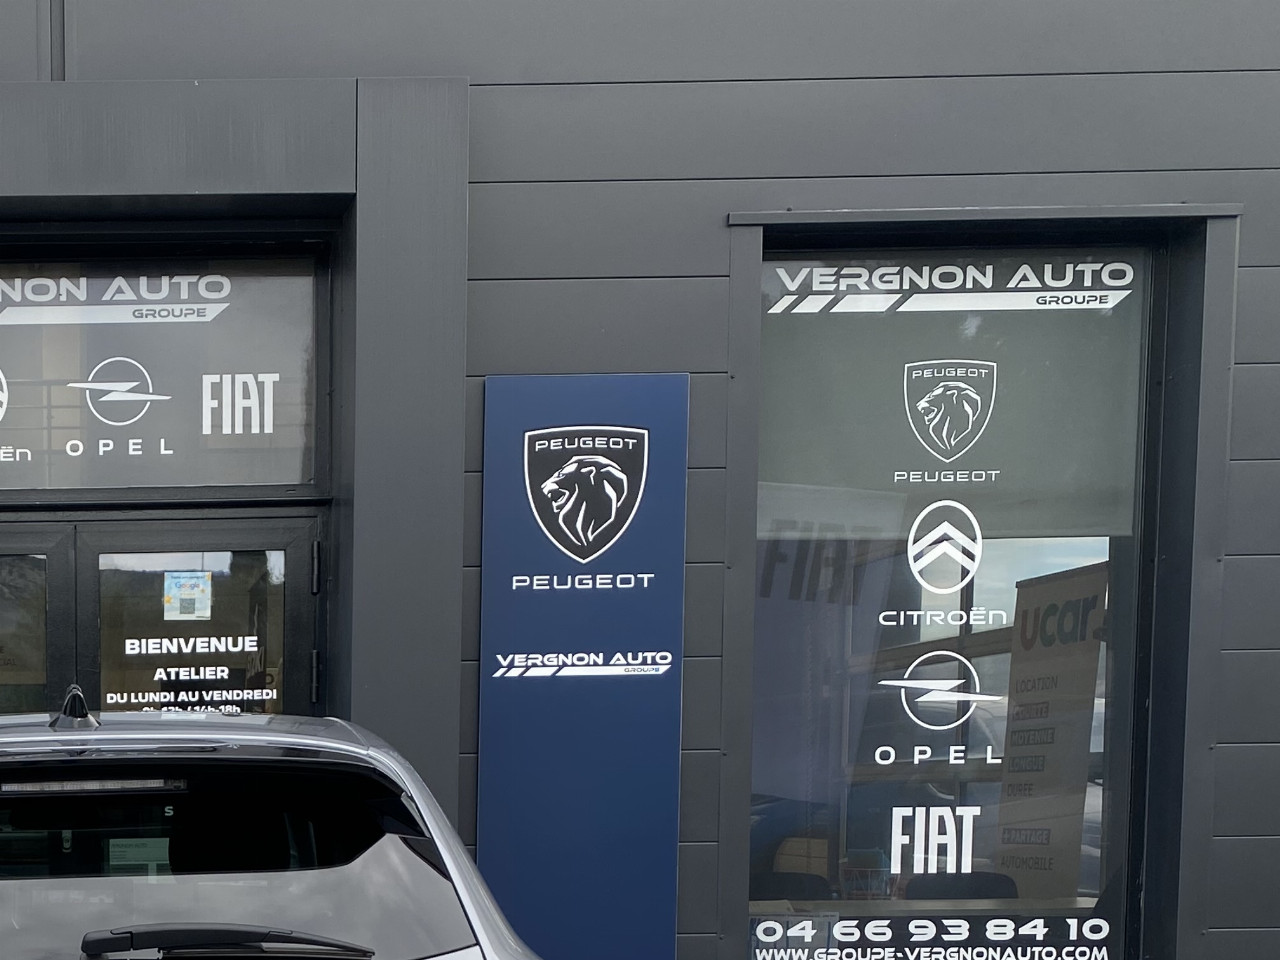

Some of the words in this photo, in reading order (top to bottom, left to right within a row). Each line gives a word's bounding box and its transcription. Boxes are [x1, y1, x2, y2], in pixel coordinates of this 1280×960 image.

[775, 264, 993, 292] VERGNON
[1005, 262, 1135, 288] AUTO
[101, 275, 232, 301] AUTO
[1035, 294, 1109, 305] GROUPE
[132, 308, 207, 319] GROUPE
[911, 367, 989, 379] PEUGEOT
[202, 373, 279, 435] FIAT
[65, 438, 174, 457] OPEL
[535, 437, 637, 452] PEUGEOT
[894, 470, 1001, 483] PEUGEOT
[512, 573, 655, 590] PEUGEOT
[878, 607, 1007, 626] CITROËN
[1020, 595, 1098, 651] ucar
[125, 636, 258, 655] BIENVENUE
[496, 652, 603, 667] VERGNON
[609, 651, 672, 665] AUTO
[153, 666, 229, 681] ATELIER
[106, 693, 127, 704] DU
[131, 691, 174, 703] LUNDI
[177, 691, 199, 702] AU
[202, 689, 277, 701] VENDREDI
[874, 745, 1002, 765] OPEL
[890, 806, 981, 874] FIAT
[755, 920, 817, 943] 04
[832, 919, 893, 942] 66
[908, 919, 970, 942] 93
[985, 918, 1049, 940] 84
[1066, 918, 1110, 940] 10
